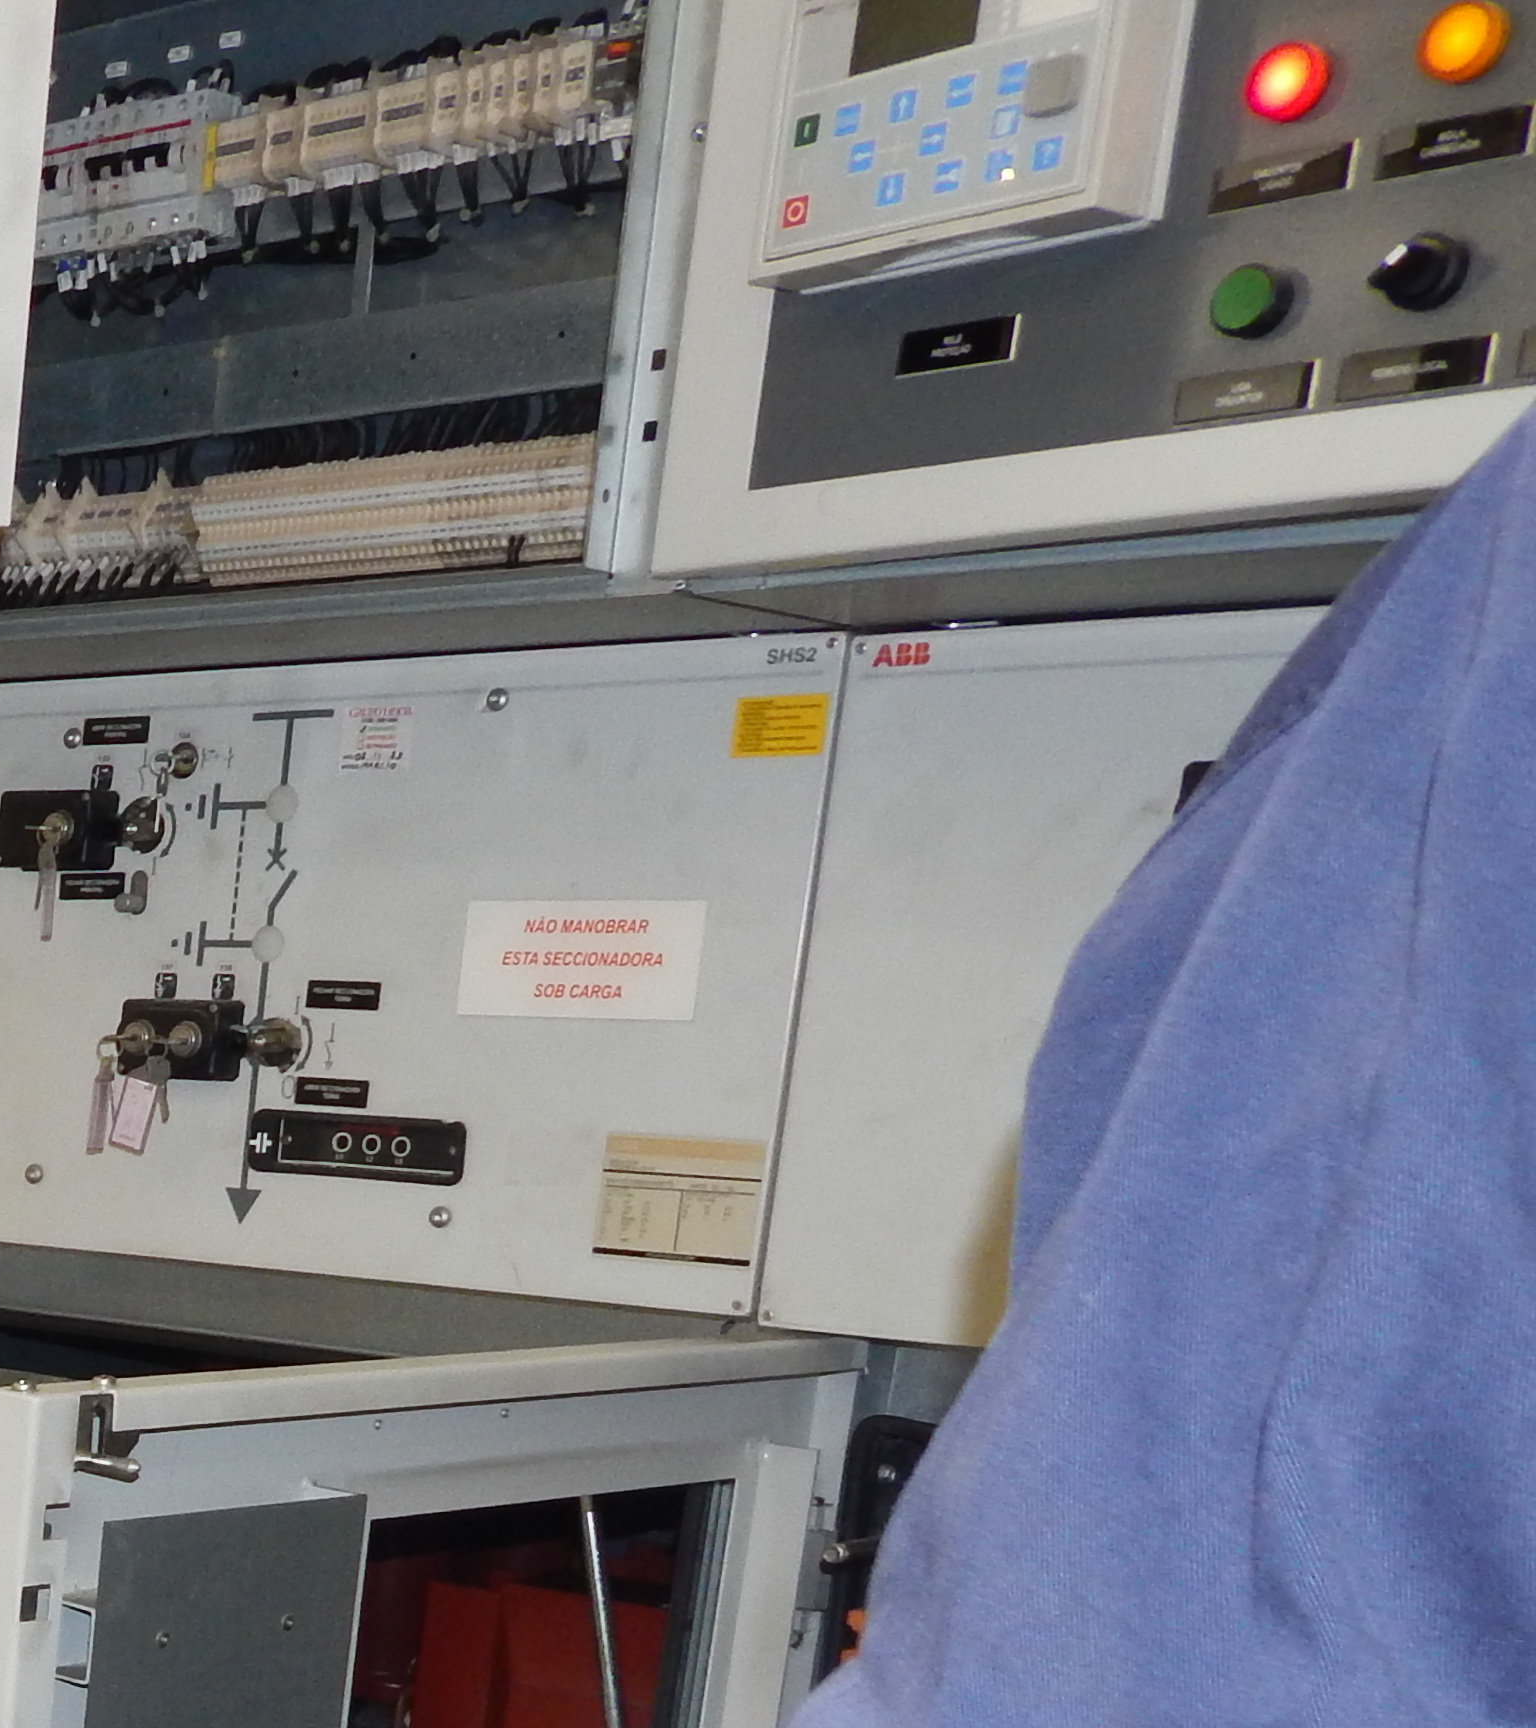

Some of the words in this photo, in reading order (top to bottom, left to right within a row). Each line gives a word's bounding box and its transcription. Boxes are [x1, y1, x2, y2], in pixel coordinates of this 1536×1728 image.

[766, 647, 818, 664] SHS2
[871, 642, 931, 668] ABB
[524, 915, 558, 933] NÃO
[560, 918, 649, 934] MANOBRAR
[501, 950, 538, 966] ESTA
[542, 951, 663, 967] SECCIONADORA
[533, 983, 565, 998] SOB
[569, 984, 622, 999] CARGA
